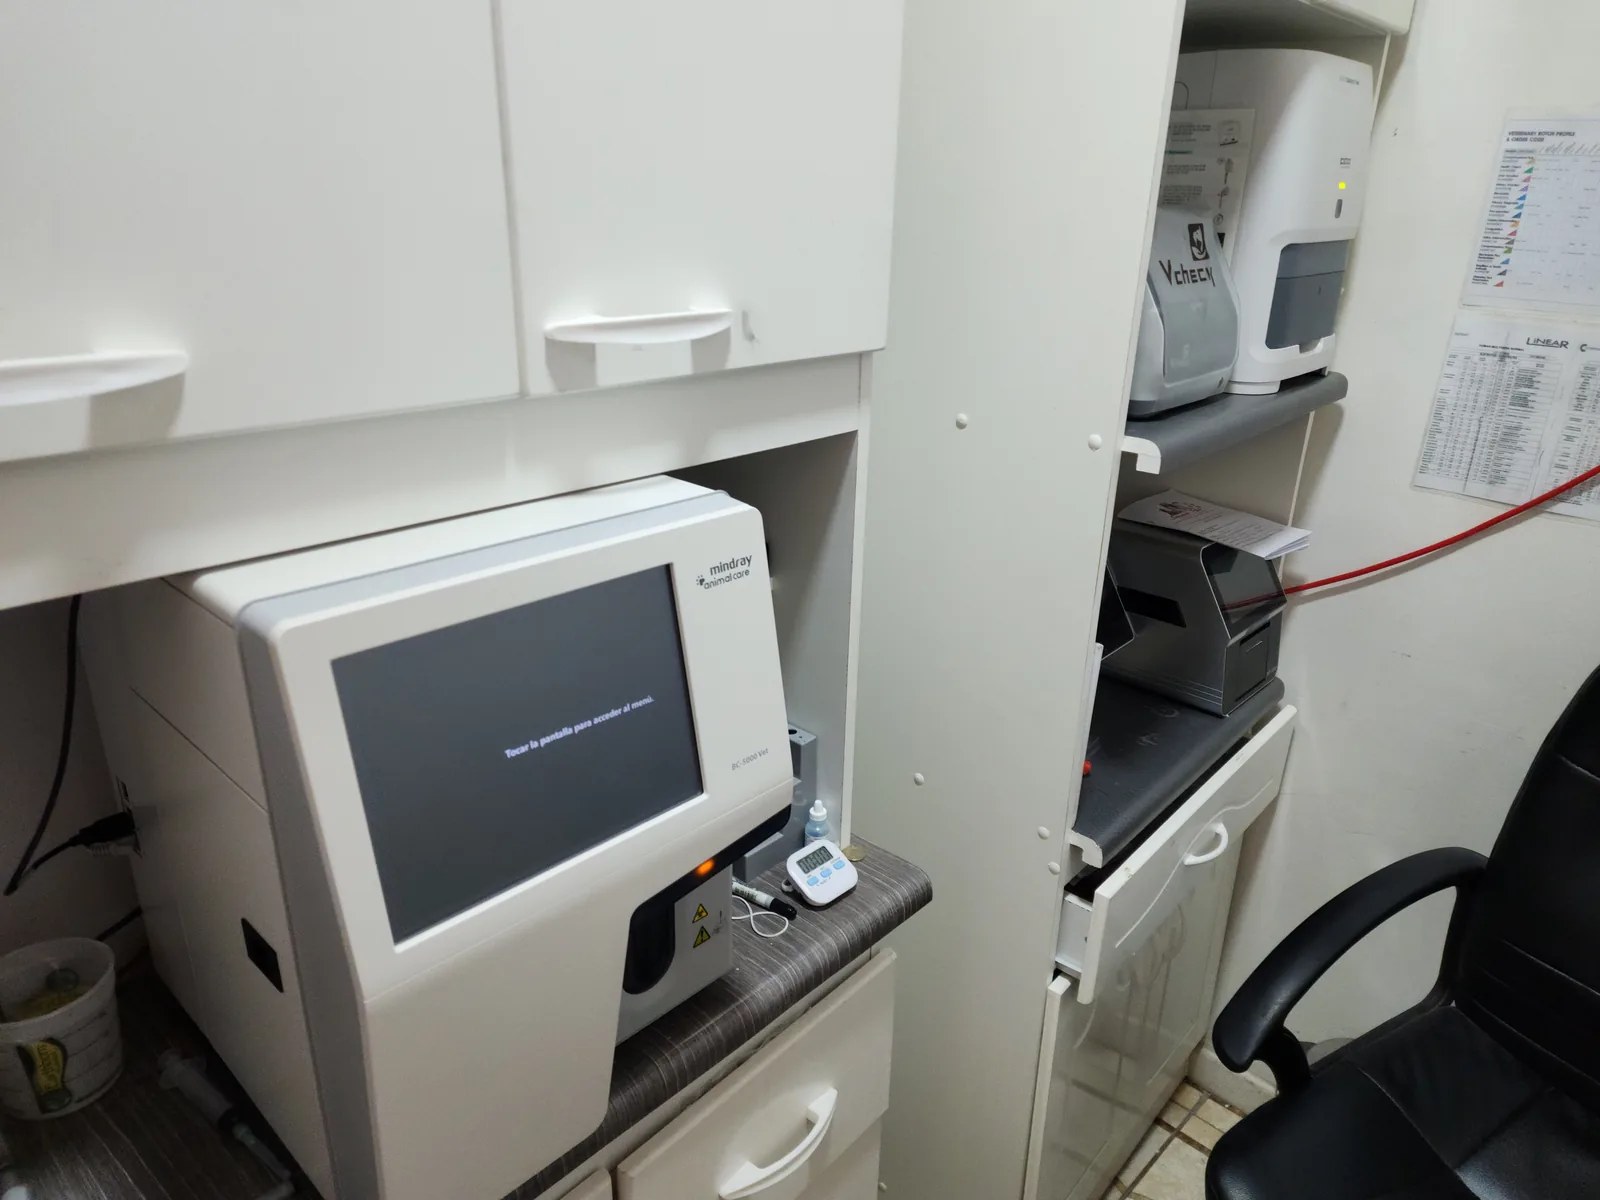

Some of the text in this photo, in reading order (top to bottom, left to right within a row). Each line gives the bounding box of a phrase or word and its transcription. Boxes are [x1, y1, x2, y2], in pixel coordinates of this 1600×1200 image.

[709, 554, 752, 576] mindray
[504, 744, 530, 759] Tocar
[529, 740, 539, 750] la
[539, 727, 574, 748] pantalla
[574, 719, 592, 735] para
[593, 707, 623, 726] acceder
[622, 703, 632, 714] al
[731, 747, 769, 771] BC-5000 Vet
